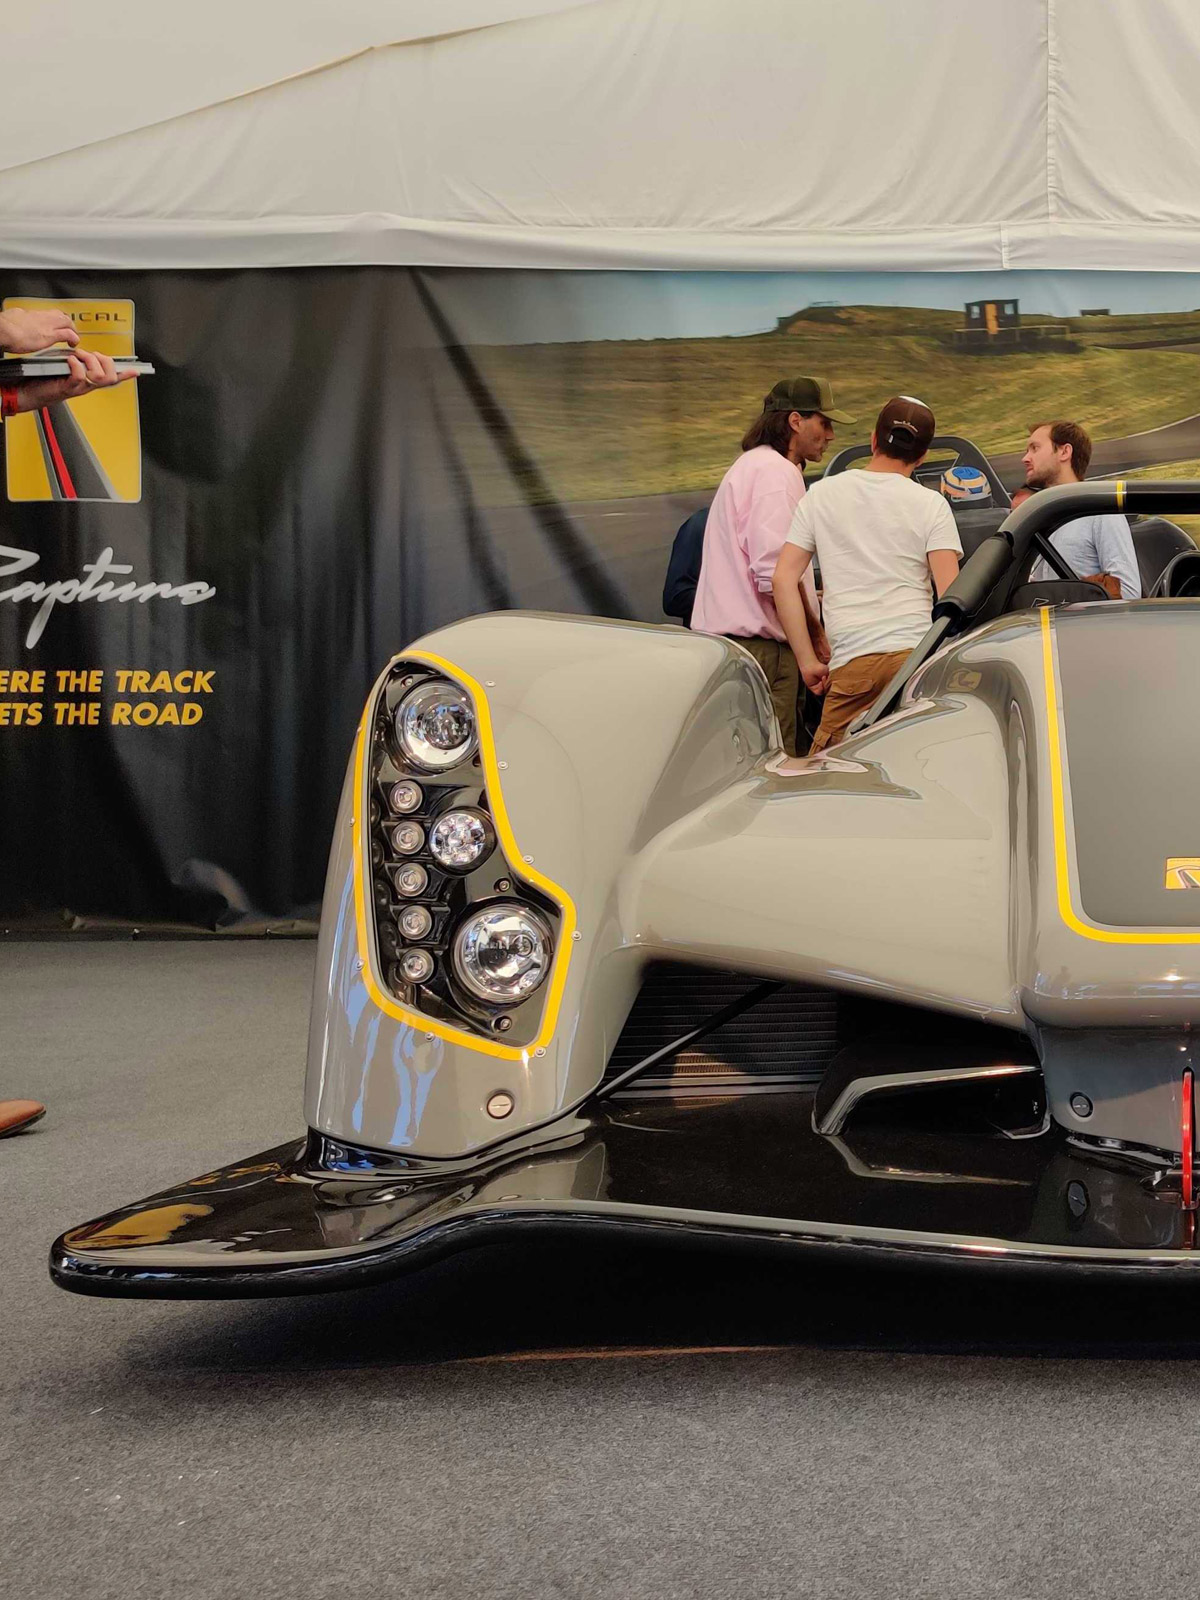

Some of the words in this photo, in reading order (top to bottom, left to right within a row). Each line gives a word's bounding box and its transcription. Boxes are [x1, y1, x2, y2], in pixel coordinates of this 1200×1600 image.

[70, 312, 127, 322] ICAL
[0, 670, 46, 693] ERE
[56, 670, 104, 693] THE
[115, 670, 216, 693] TRACK
[0, 702, 43, 726] ETS
[54, 702, 101, 726] THE
[111, 702, 203, 726] ROAD
